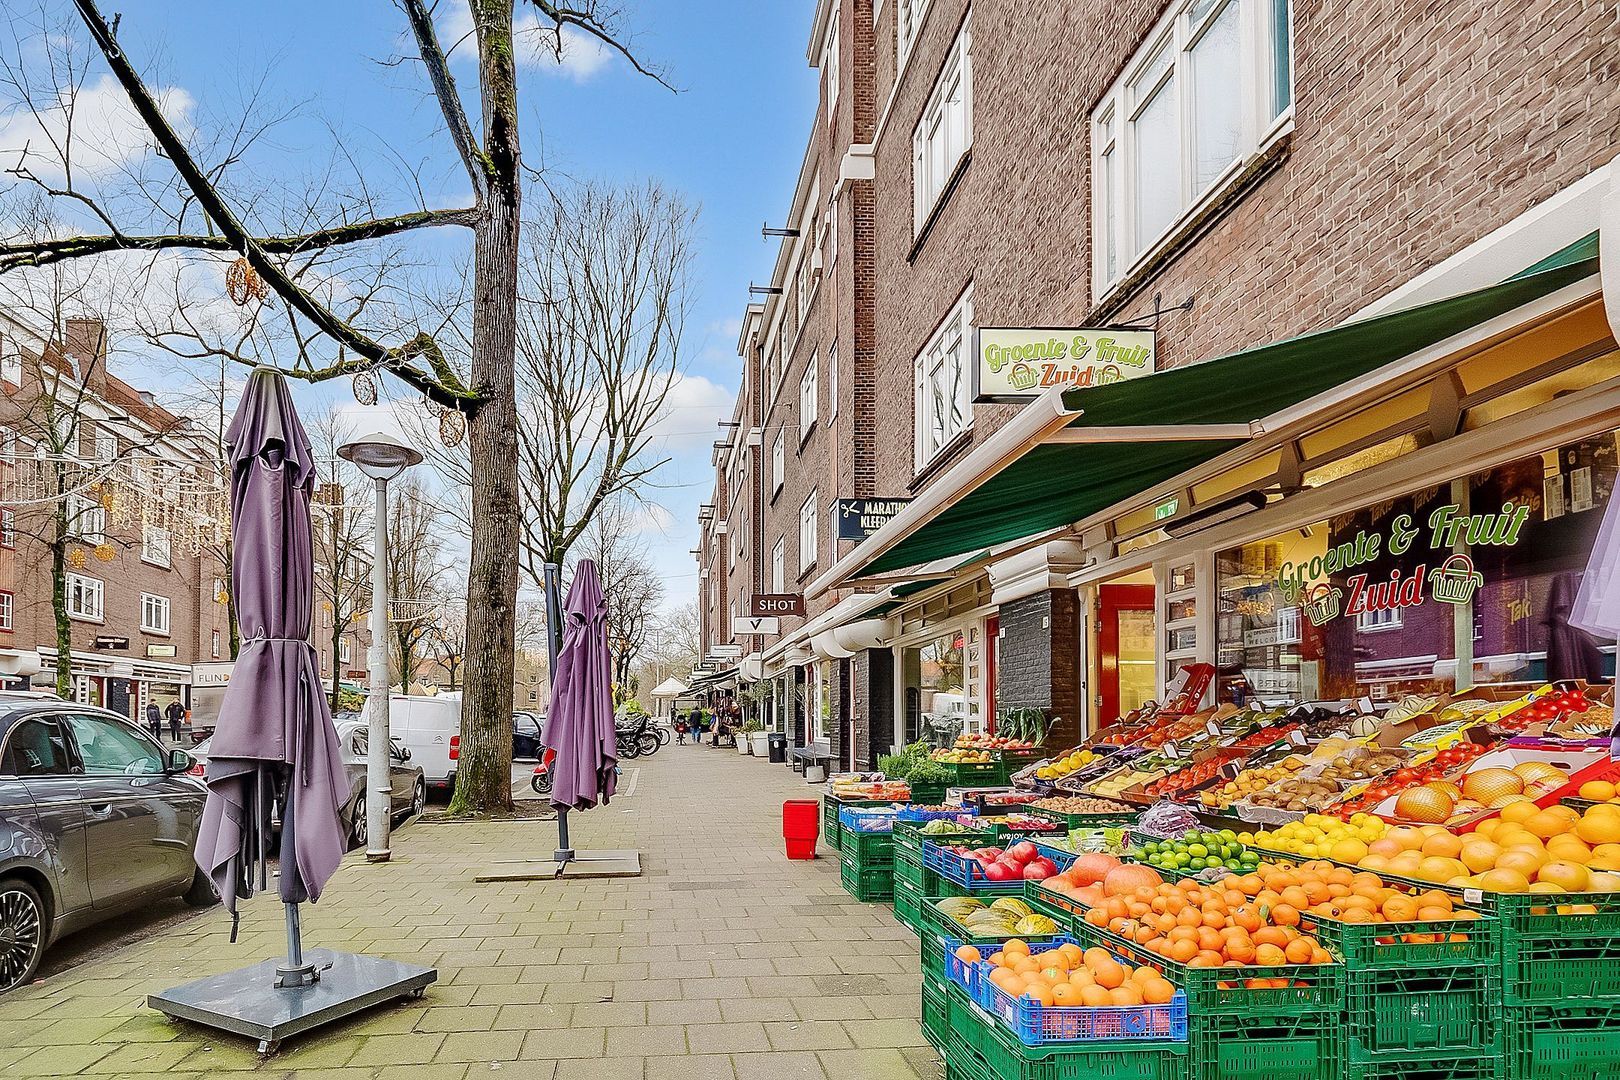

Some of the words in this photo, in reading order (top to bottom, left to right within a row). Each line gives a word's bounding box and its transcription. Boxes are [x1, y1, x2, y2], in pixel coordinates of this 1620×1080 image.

[985, 338, 1067, 372] Groente
[1070, 336, 1092, 360] &
[1096, 337, 1150, 367] Fruit
[1040, 363, 1095, 387] Zuid
[864, 501, 911, 515] MARATHO
[1278, 530, 1381, 603] Groente
[1389, 514, 1419, 555] &
[1429, 501, 1530, 549] Fruit
[759, 600, 796, 610] SHOT
[1344, 564, 1426, 616] Zuid
